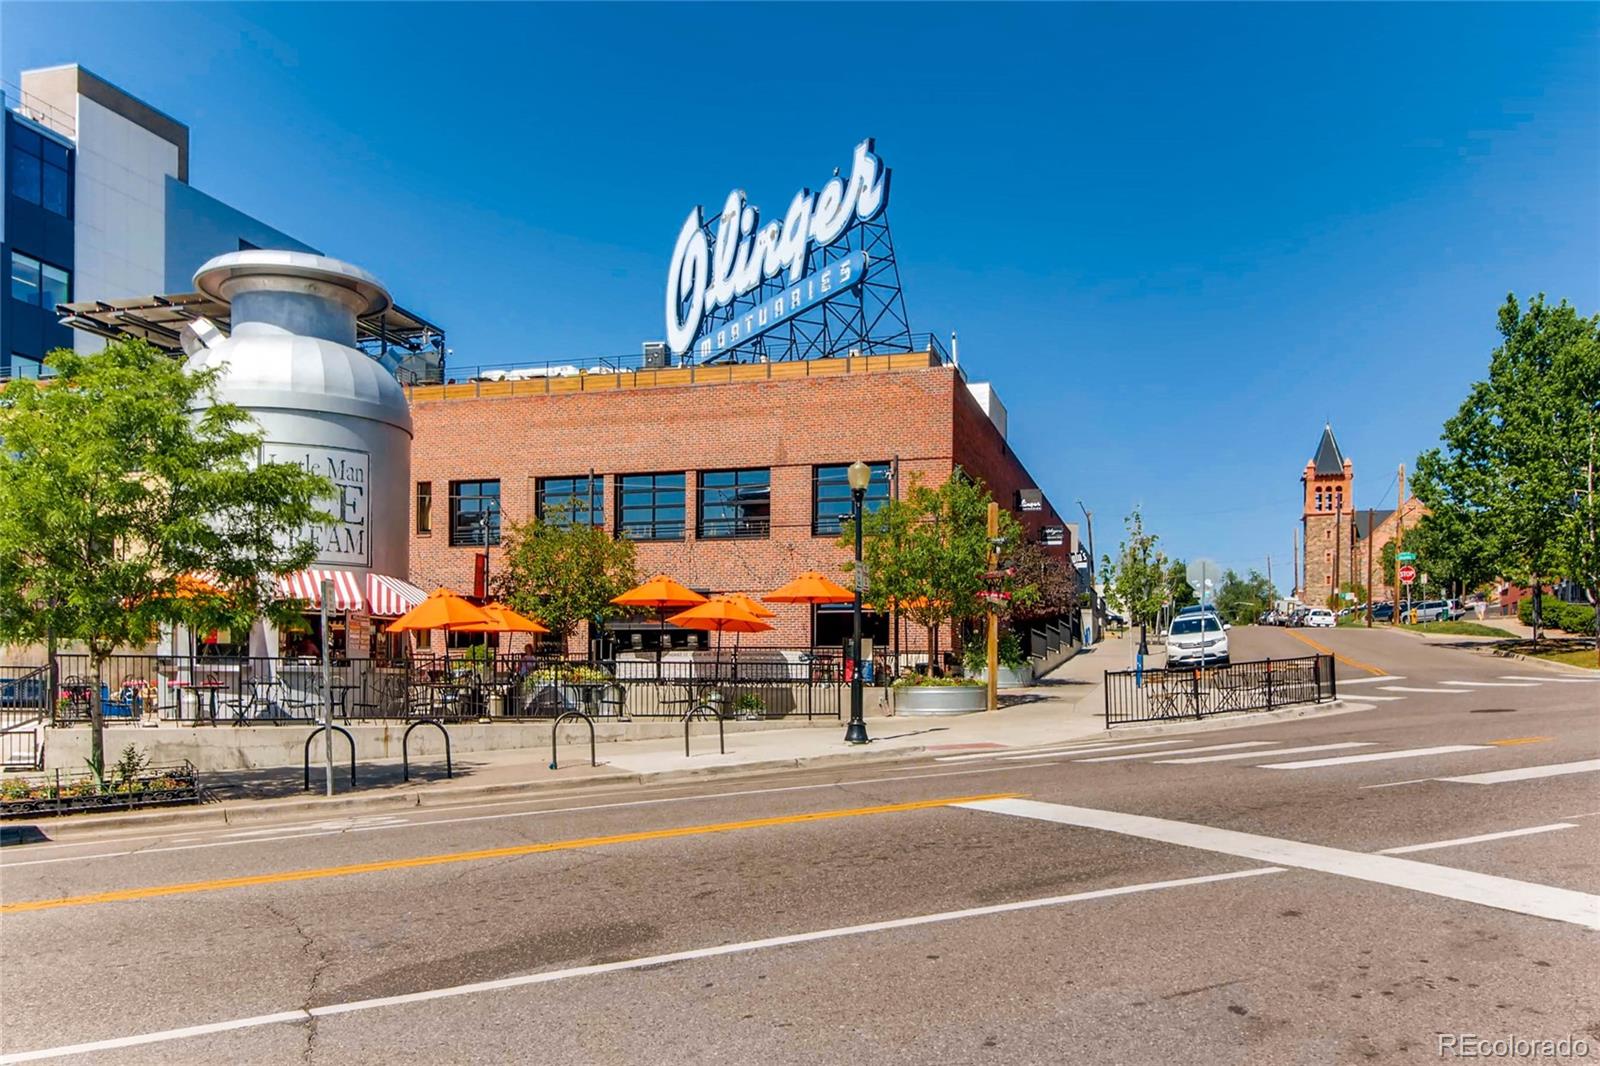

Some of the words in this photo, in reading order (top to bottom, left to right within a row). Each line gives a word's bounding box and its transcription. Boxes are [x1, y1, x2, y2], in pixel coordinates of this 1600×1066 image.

[666, 137, 891, 354] Olinger
[700, 259, 852, 357] MORTUARIES
[327, 456, 364, 483] Man
